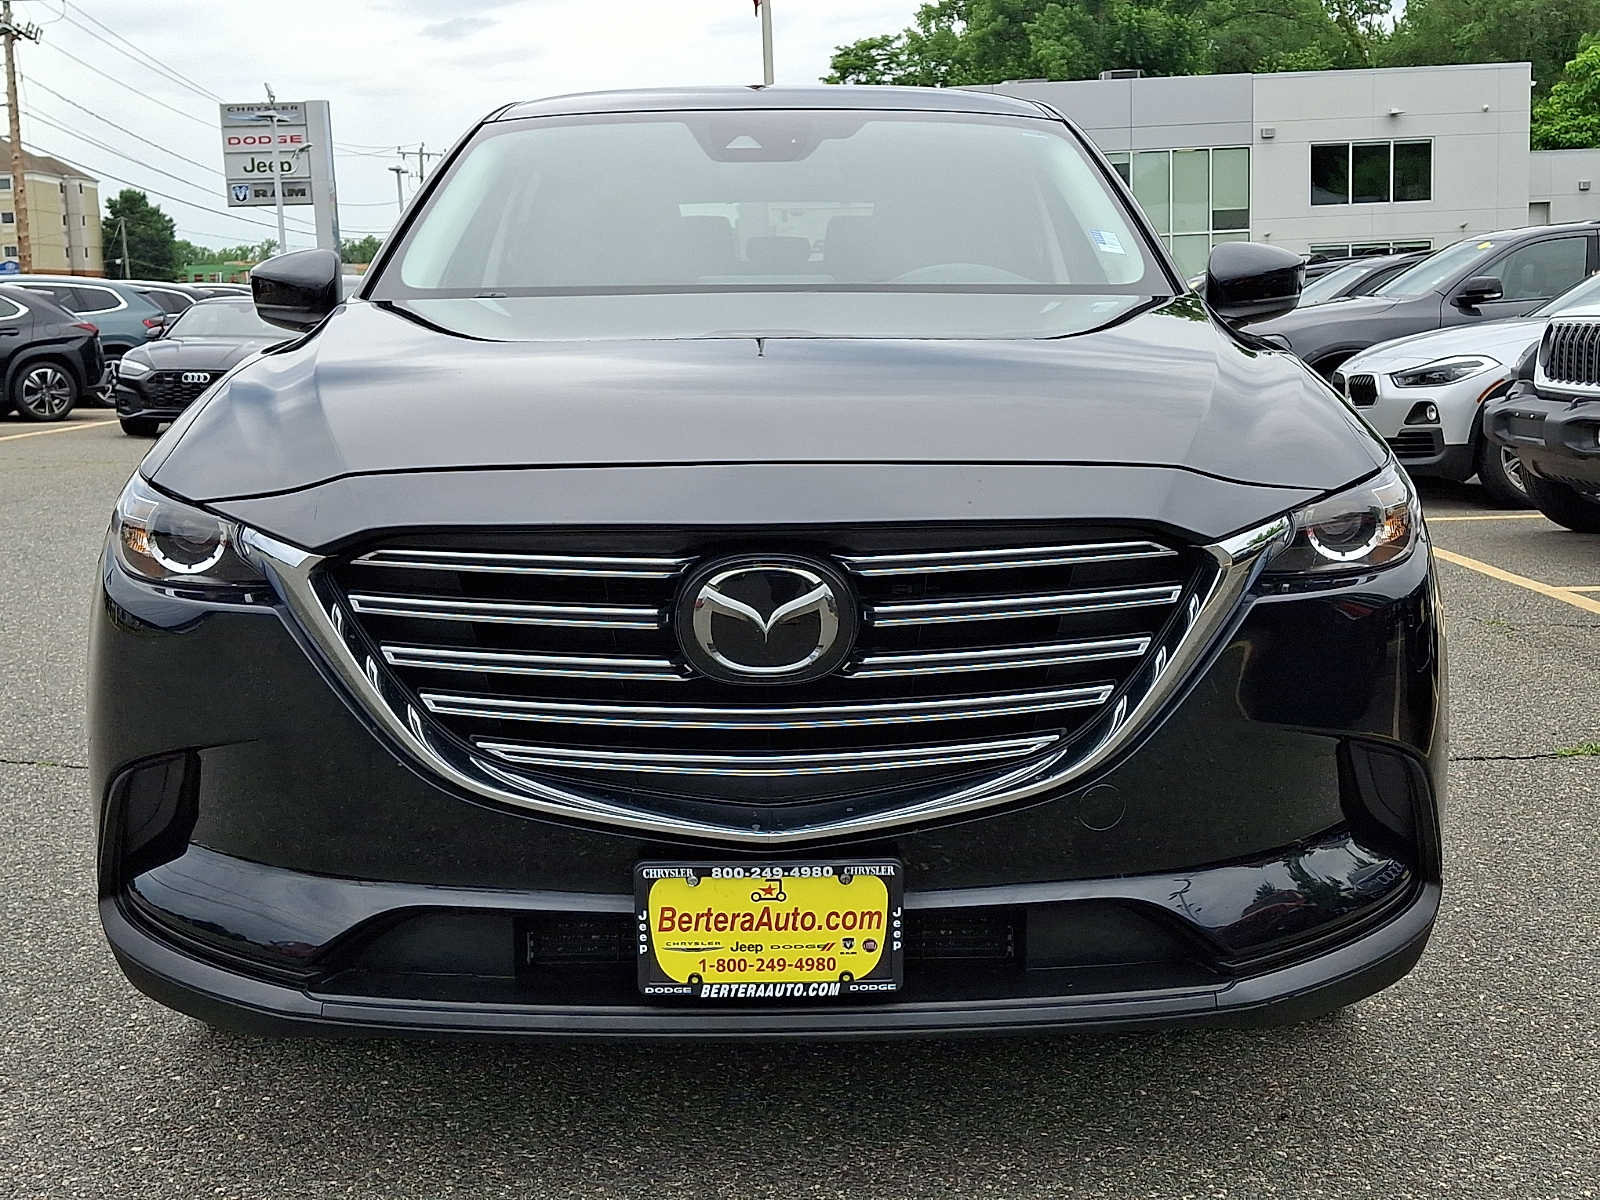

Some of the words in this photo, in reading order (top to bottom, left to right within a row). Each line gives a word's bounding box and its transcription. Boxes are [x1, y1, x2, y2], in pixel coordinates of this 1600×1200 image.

[227, 134, 303, 146] DODGE
[642, 867, 695, 879] CHRYSLER
[711, 866, 834, 880] 800-249-4980
[843, 865, 896, 876] CHRYSLER
[658, 905, 883, 932] BerteraAuto.com
[638, 909, 648, 955] Jeep
[892, 906, 902, 951] Jeep
[730, 940, 764, 955] Jeep
[698, 957, 837, 973] 1-800-249-4980
[644, 986, 692, 995] DODGE
[700, 982, 841, 998] BERTERAAUTO.COM
[849, 983, 897, 992] DODGE
